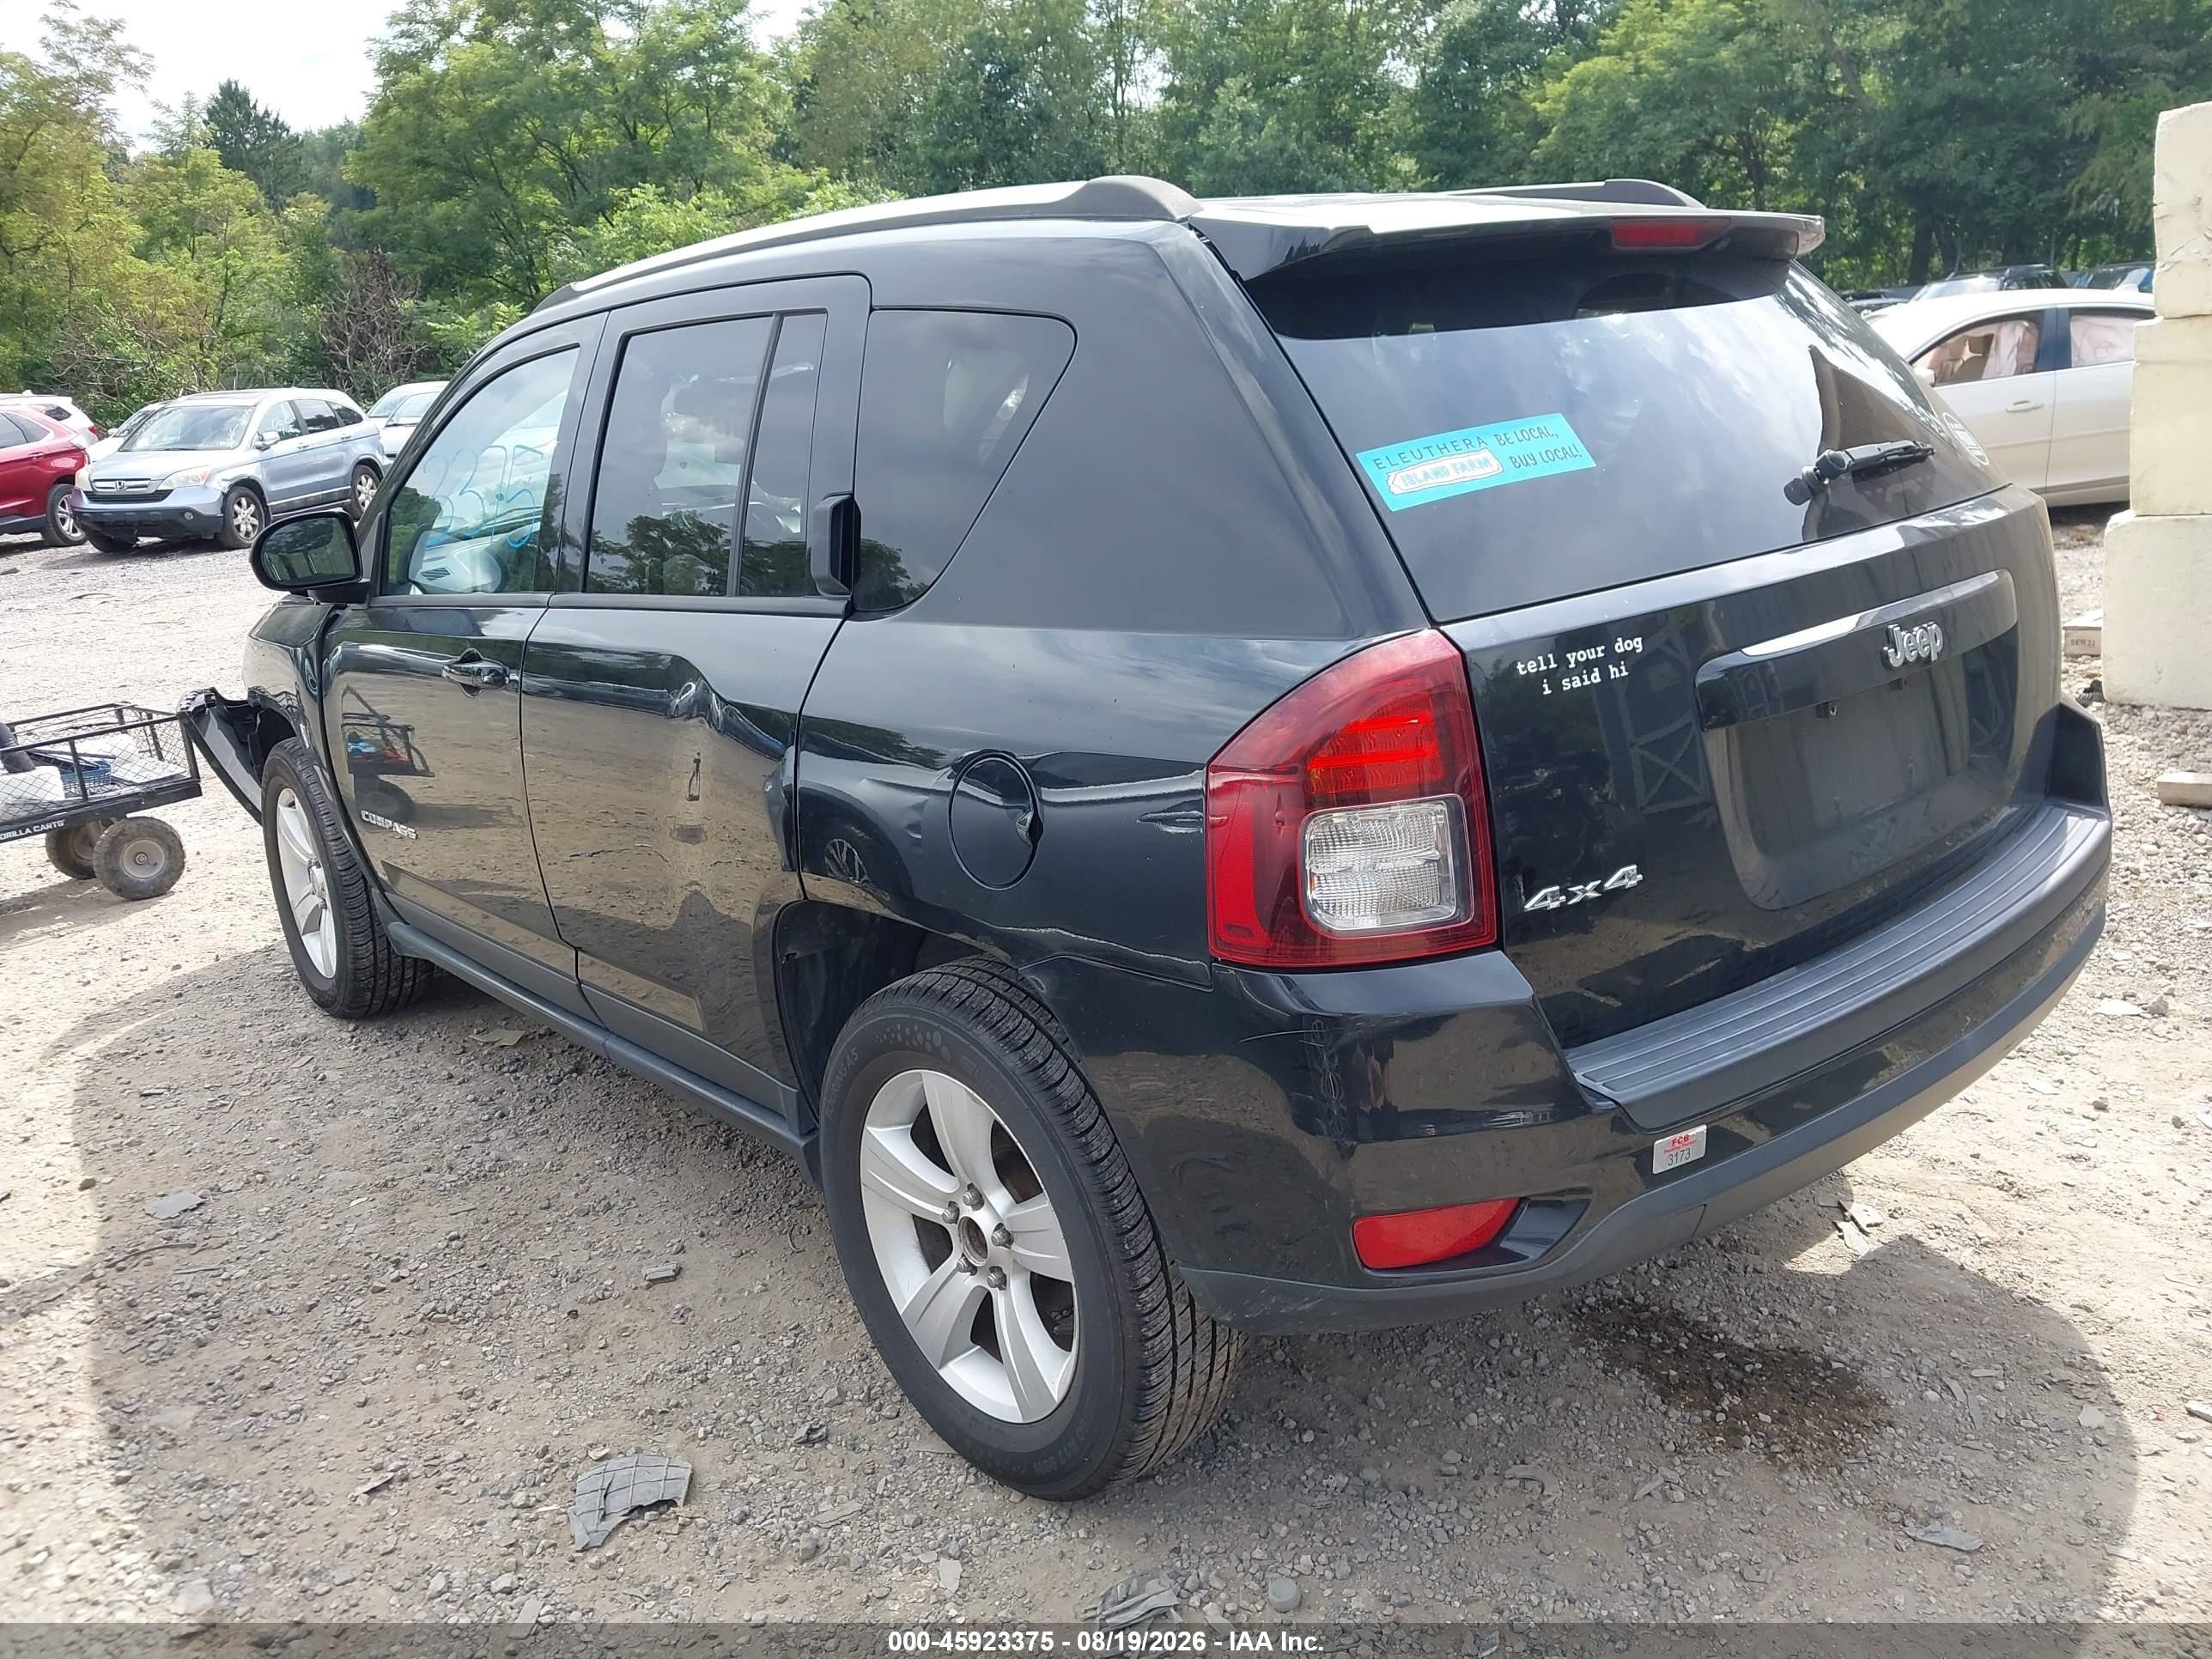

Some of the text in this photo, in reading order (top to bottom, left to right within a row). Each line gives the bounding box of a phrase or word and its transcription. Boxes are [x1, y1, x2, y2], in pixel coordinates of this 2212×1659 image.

[1374, 436, 1488, 470] ELEUTHERA
[1493, 433, 1515, 447] BE
[1509, 443, 1582, 469] BUY LOCAL!
[1516, 637, 1643, 675] tell your dog
[1883, 621, 1943, 667] Jeep
[1542, 660, 1629, 695] i said hi
[33, 820, 64, 832] CARTS
[361, 810, 418, 840] COMPASS
[1523, 864, 1644, 912] 4x4
[1668, 1147, 1691, 1166] 3173
